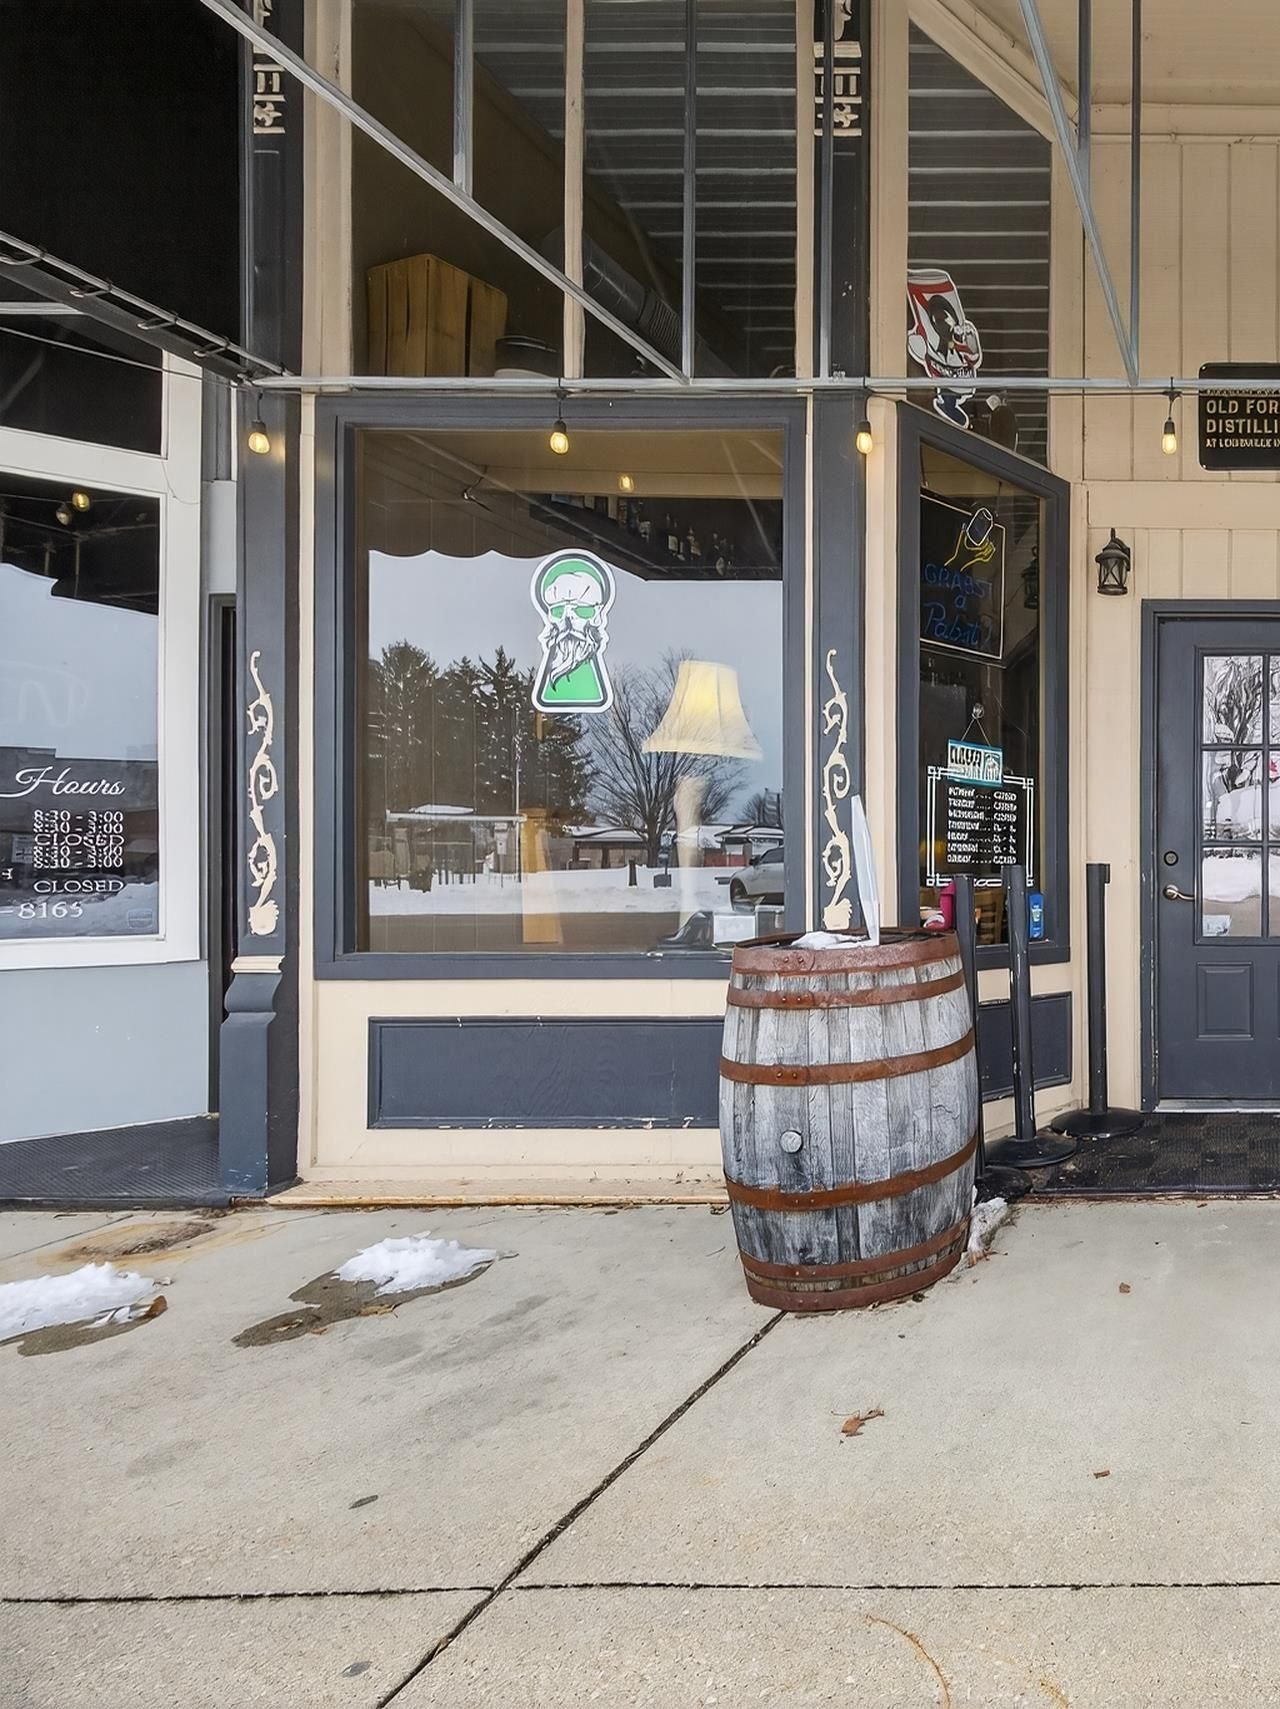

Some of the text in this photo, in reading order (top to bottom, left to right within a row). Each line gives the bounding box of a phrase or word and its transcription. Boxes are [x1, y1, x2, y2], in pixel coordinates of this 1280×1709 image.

[1206, 400, 1239, 414] OLD
[1206, 438, 1216, 448] AT
[0, 766, 126, 798] Hours
[34, 880, 125, 893] CLOSED
